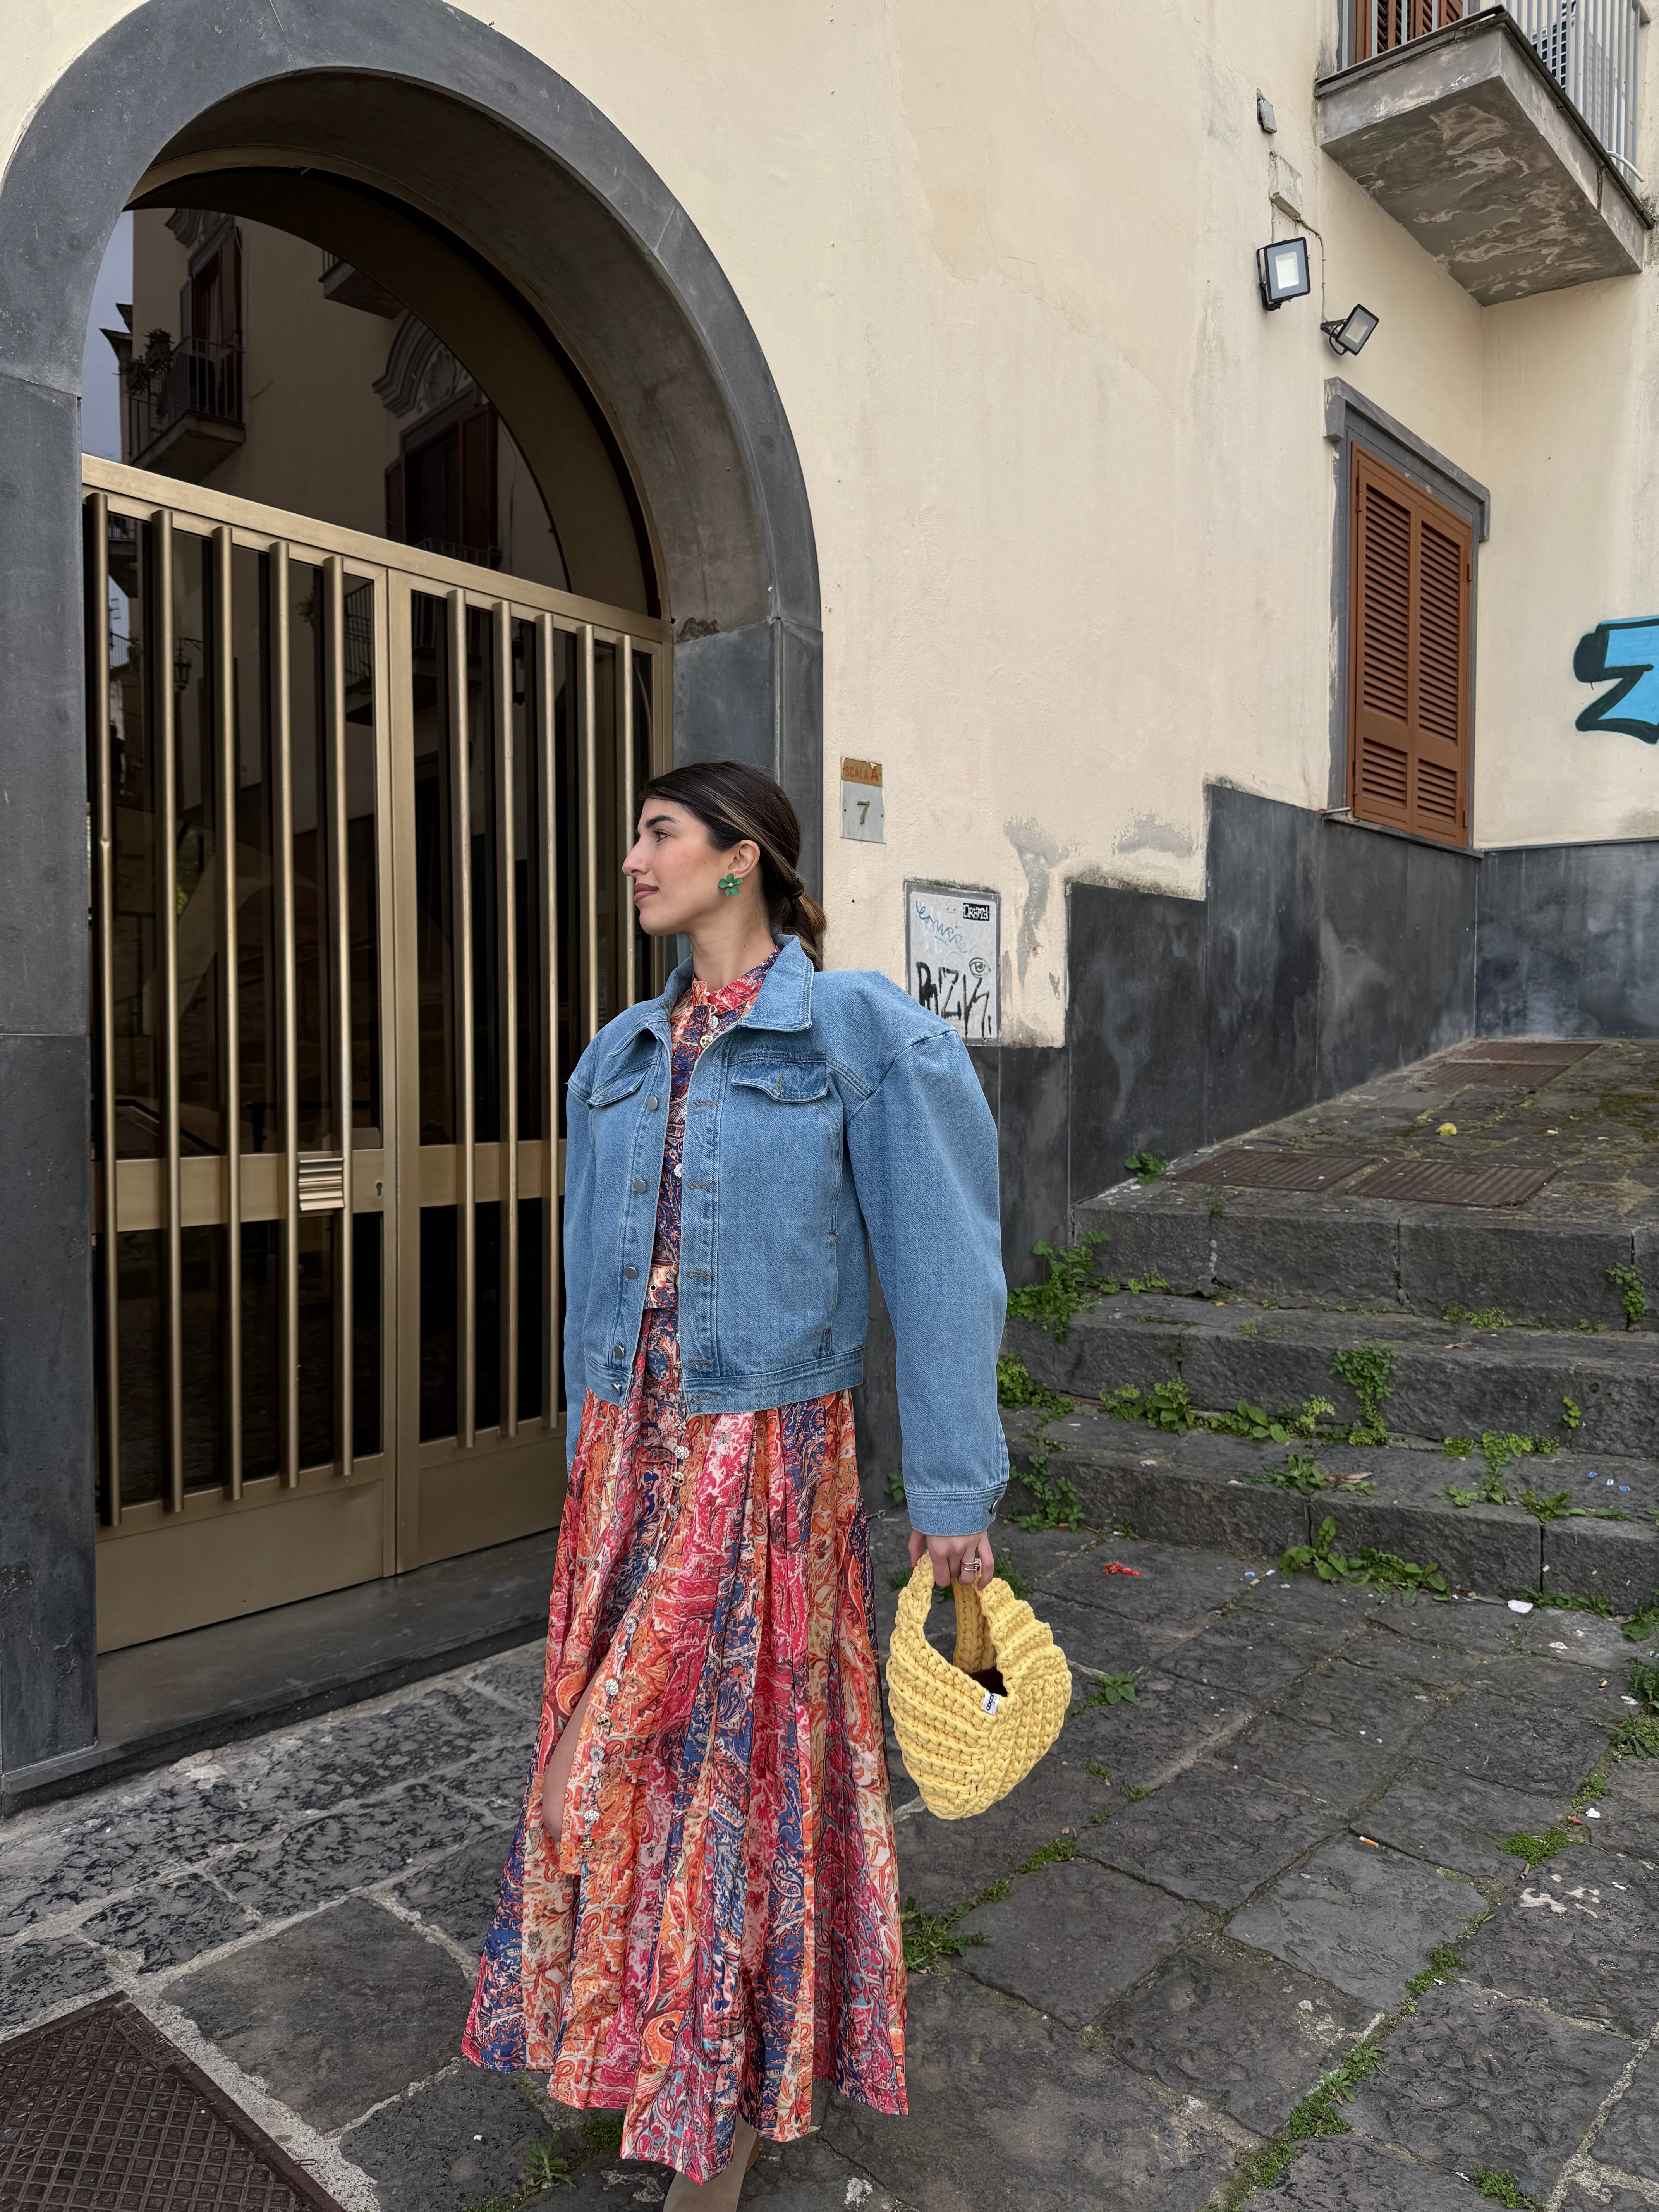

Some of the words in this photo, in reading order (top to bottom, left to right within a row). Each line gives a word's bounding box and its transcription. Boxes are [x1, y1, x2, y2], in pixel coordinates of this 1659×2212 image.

[845, 766, 869, 780] SCALA
[871, 766, 878, 781] A
[857, 801, 870, 824] 7
